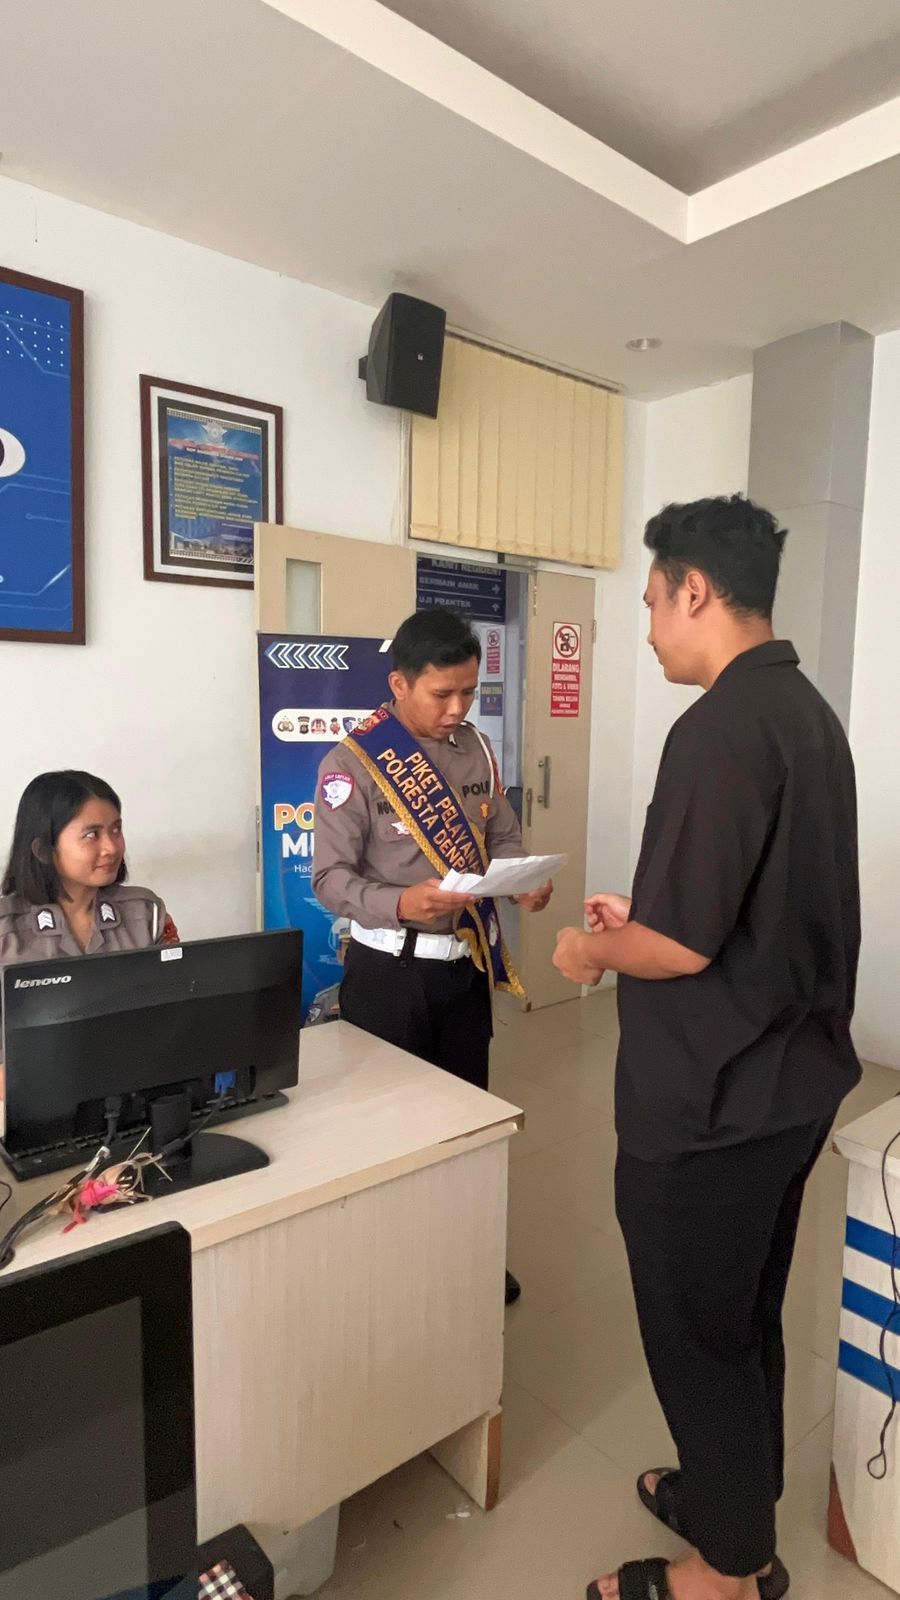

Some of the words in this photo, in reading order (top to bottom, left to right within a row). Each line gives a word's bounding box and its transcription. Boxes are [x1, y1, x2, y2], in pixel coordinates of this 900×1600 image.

[552, 663, 579, 673] DILARANG
[462, 780, 489, 798] POLI
[377, 748, 439, 831] POLRESTA
[433, 829, 467, 873] DENP
[404, 751, 443, 796] PIKET
[435, 796, 482, 875] PELAYANA
[14, 975, 72, 989] lenovo
